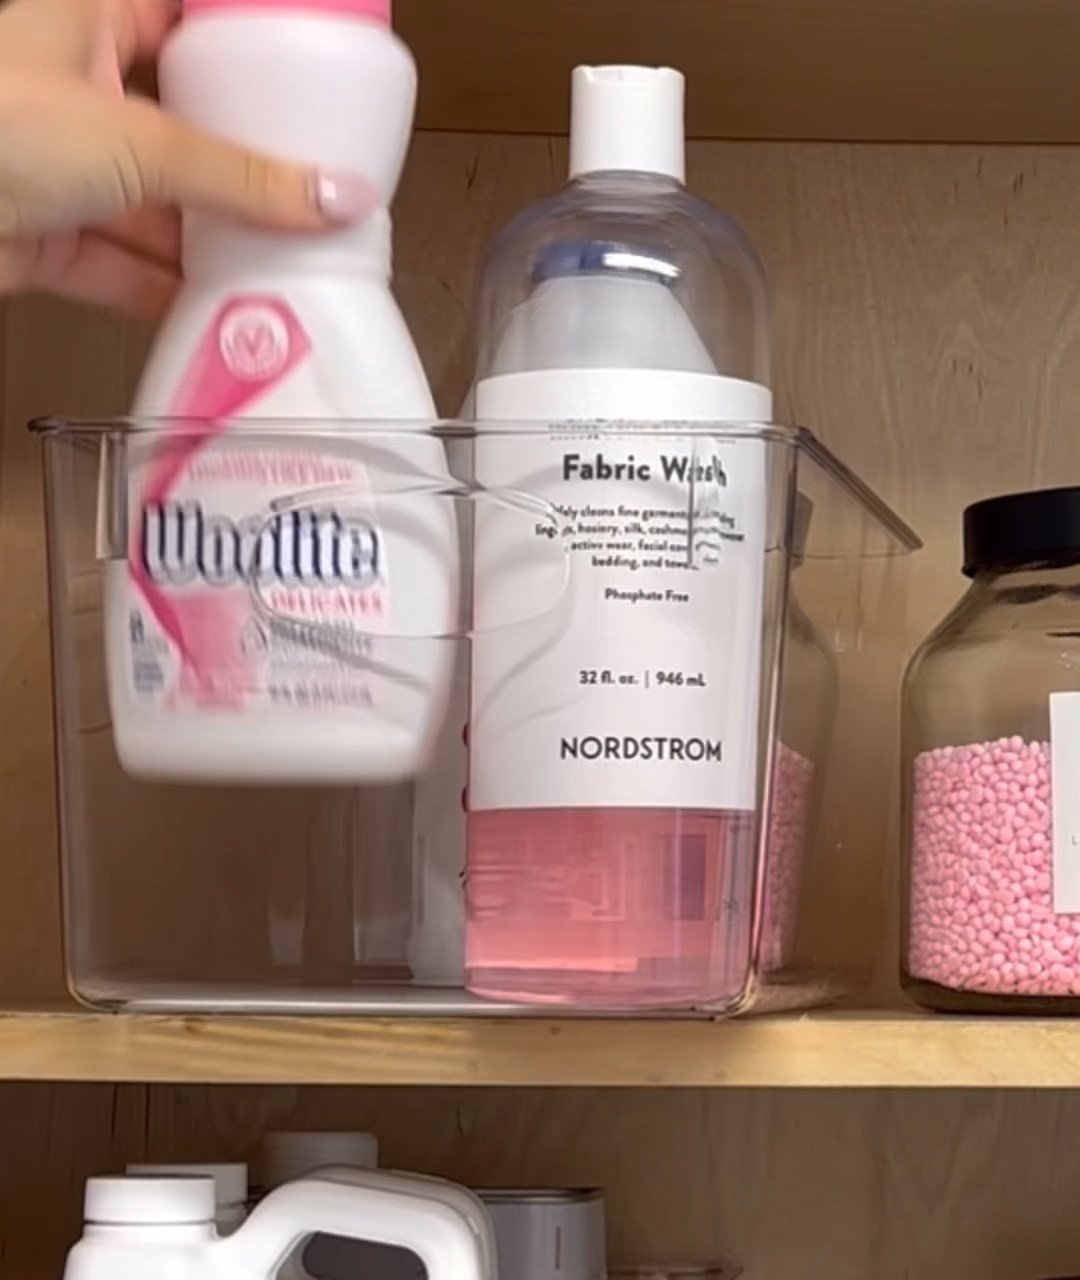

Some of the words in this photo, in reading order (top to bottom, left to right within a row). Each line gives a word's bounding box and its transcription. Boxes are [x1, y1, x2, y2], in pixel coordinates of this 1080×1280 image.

[562, 453, 651, 481] Fabric
[605, 587, 663, 603] Phosphate
[665, 589, 689, 603] Free
[579, 670, 598, 685] 32
[600, 670, 615, 685] fl.
[618, 674, 638, 685] oz.
[656, 671, 684, 686] 946
[686, 673, 707, 687] mL
[560, 736, 722, 762] NORDSTROM
